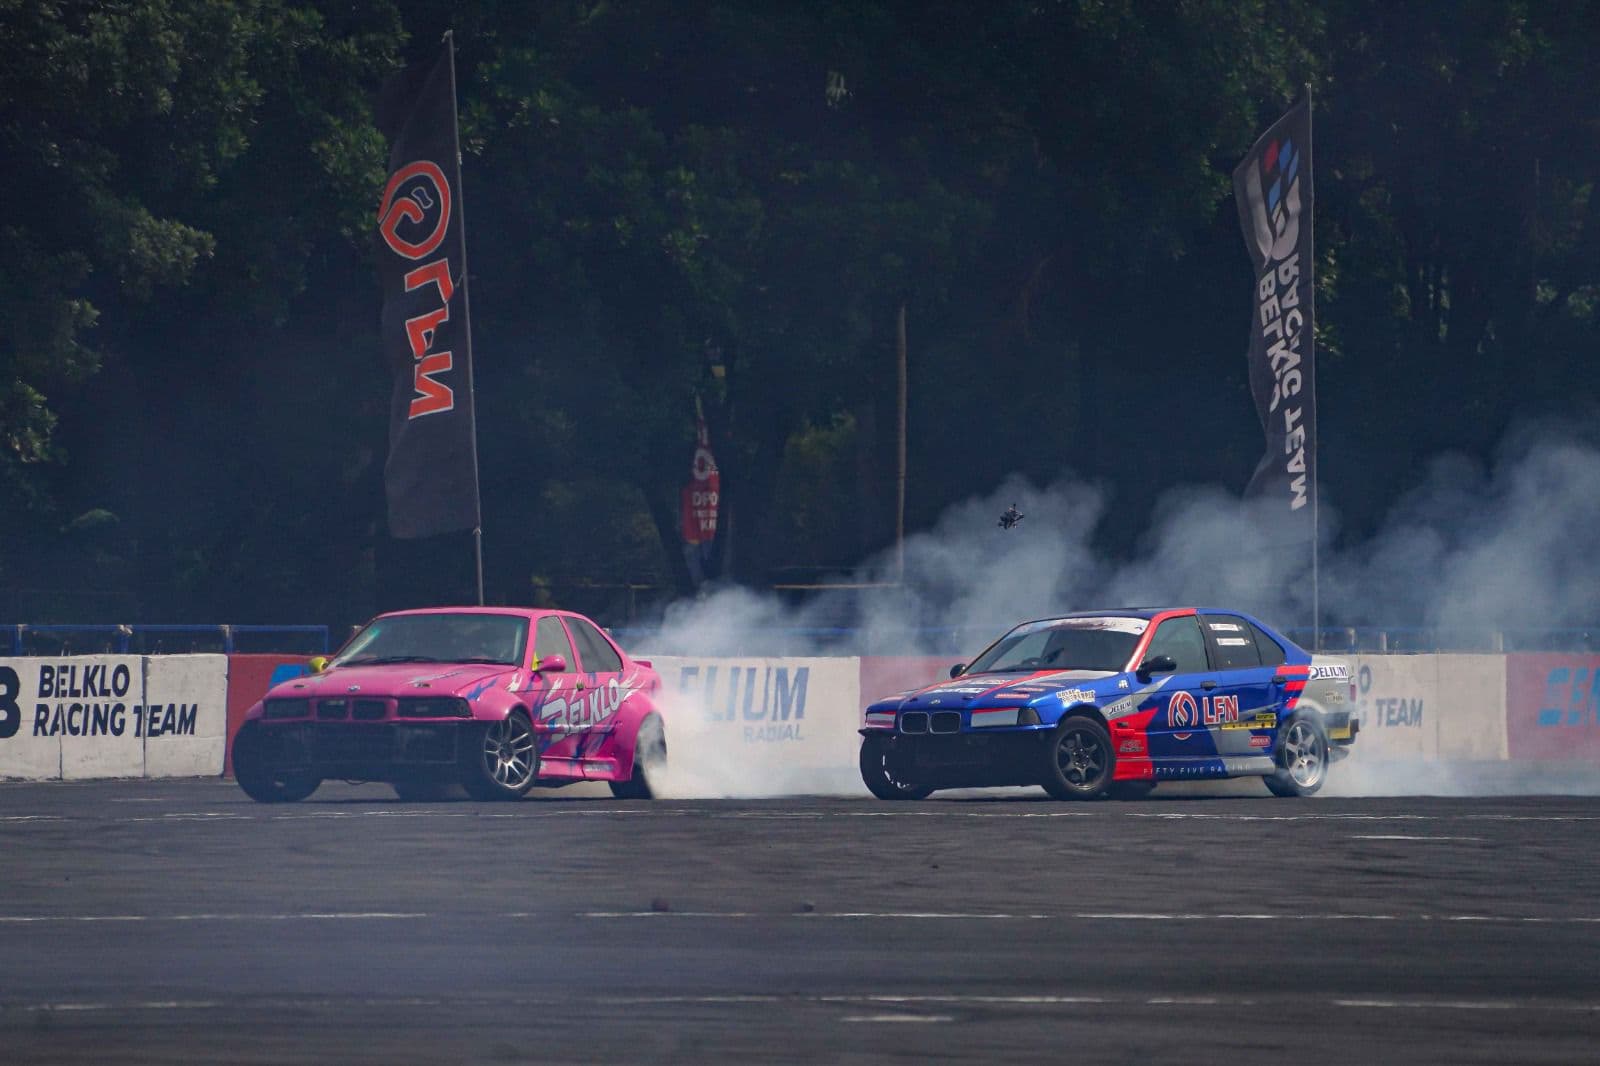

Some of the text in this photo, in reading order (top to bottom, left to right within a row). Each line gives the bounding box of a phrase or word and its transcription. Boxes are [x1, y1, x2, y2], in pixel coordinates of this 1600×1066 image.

[38, 664, 130, 698] BELKLO
[1311, 666, 1347, 680] DELIUM
[33, 703, 197, 737] RACING TEAM
[1202, 695, 1239, 725] LFN
[1376, 698, 1424, 727] TEAM
[744, 724, 804, 742] RADIAL
